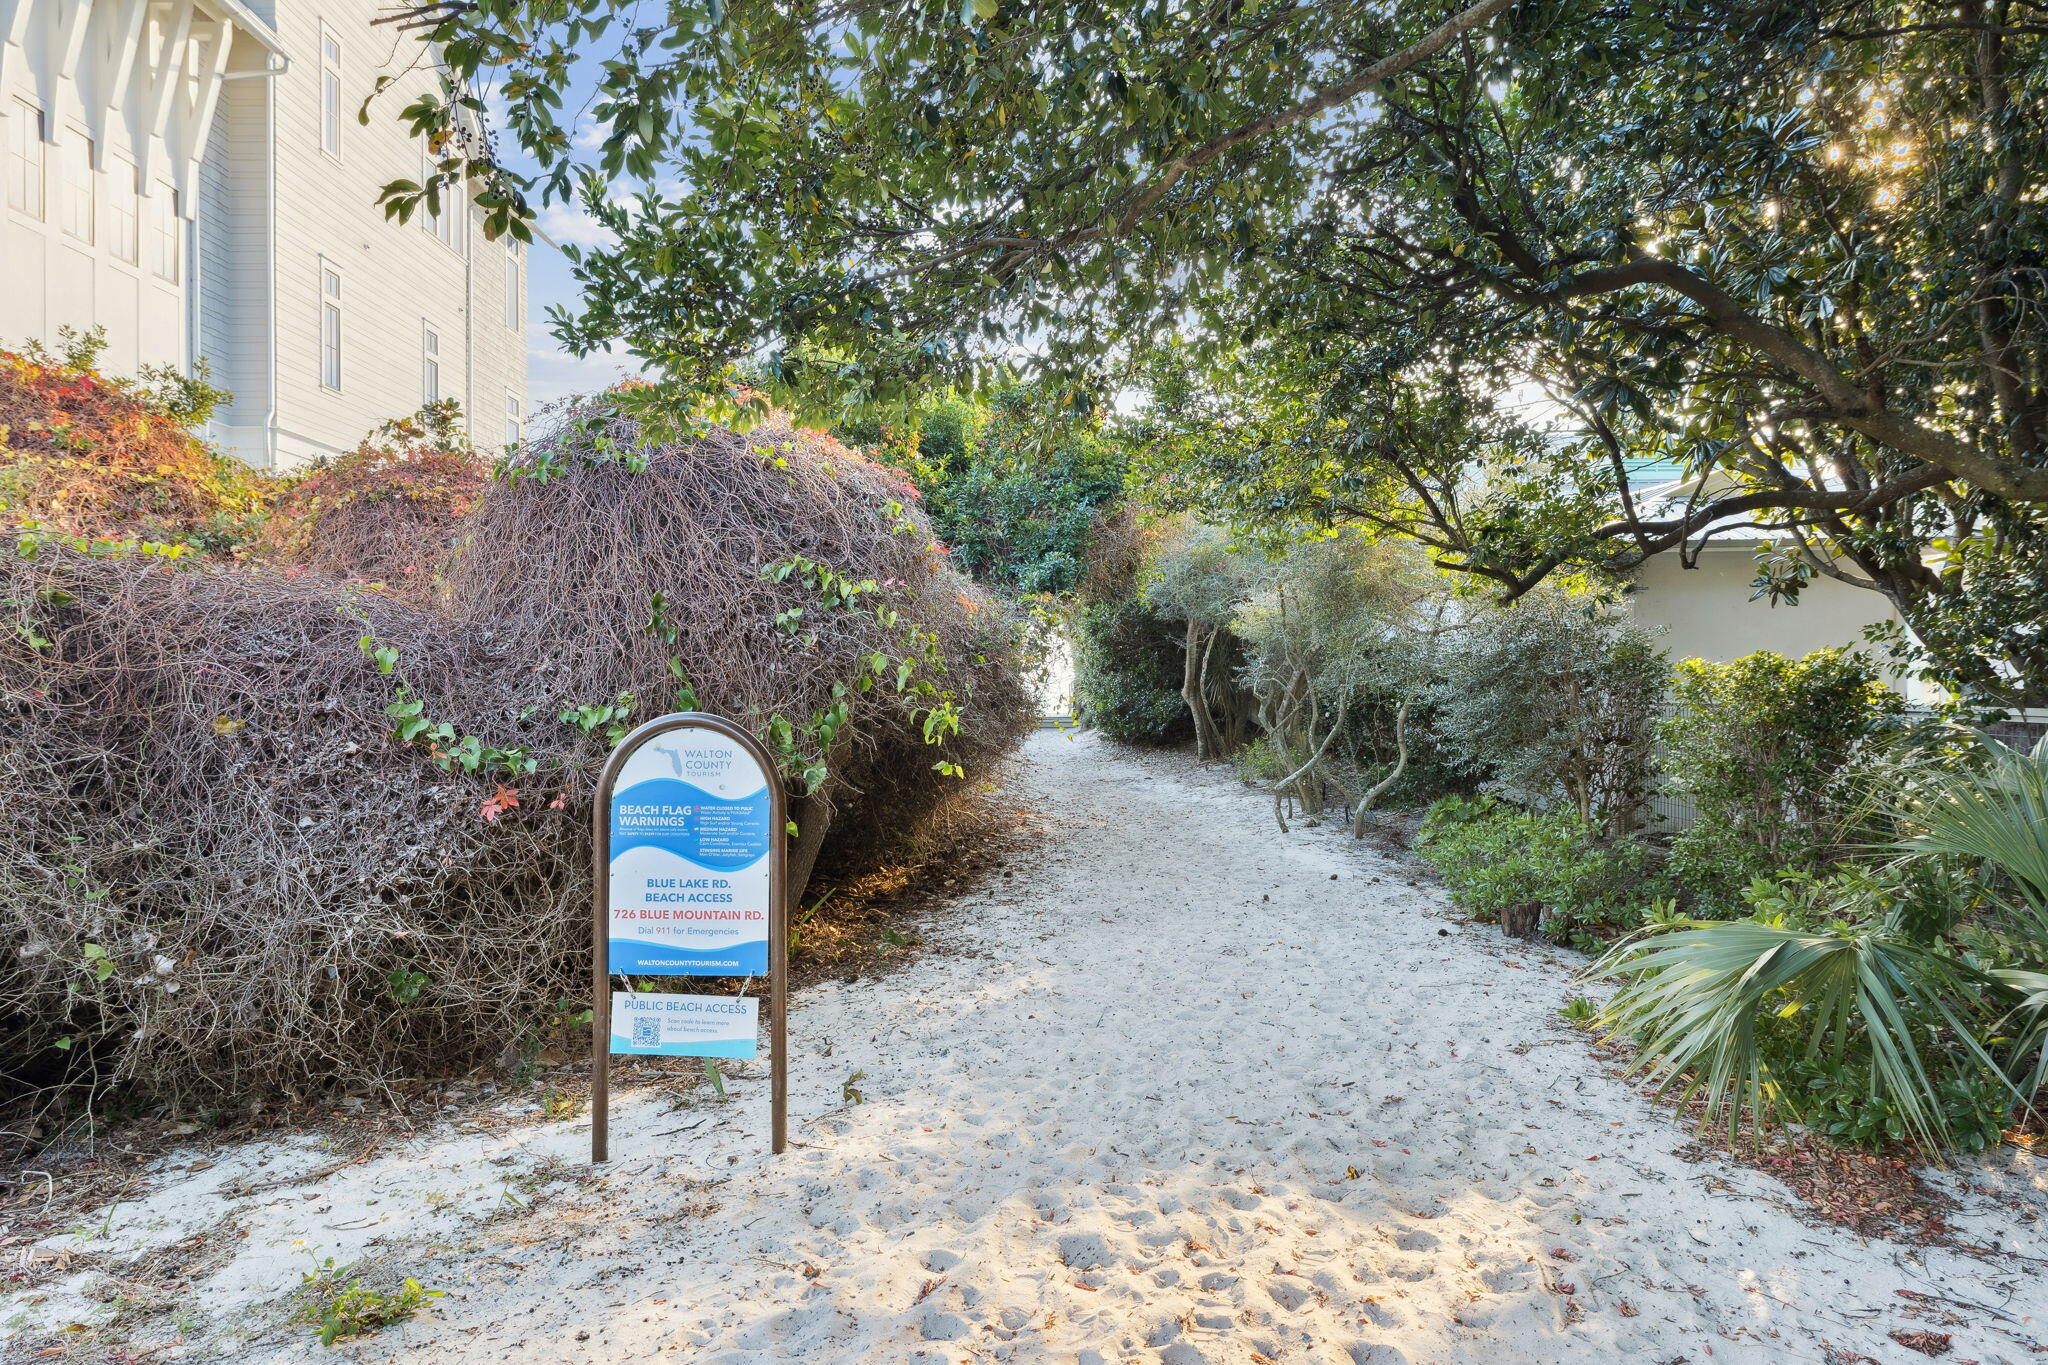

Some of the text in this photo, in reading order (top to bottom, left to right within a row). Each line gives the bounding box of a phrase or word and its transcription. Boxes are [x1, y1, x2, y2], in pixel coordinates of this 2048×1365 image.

[685, 750, 732, 758] WALTON
[685, 760, 732, 769] COUNTY
[619, 805, 692, 816] BEACH FLAG
[619, 816, 684, 826] WARNINGS
[647, 878, 731, 888] BLUE LAKE RD.
[645, 893, 732, 902] BEACH ACCESS
[614, 910, 764, 920] 726 BLUE MOUNTAIN RD.
[638, 926, 654, 934] Dial
[673, 927, 685, 935] for
[688, 928, 739, 936] Emergencies
[624, 1000, 747, 1014] PUBLIC BEACH ACCESS
